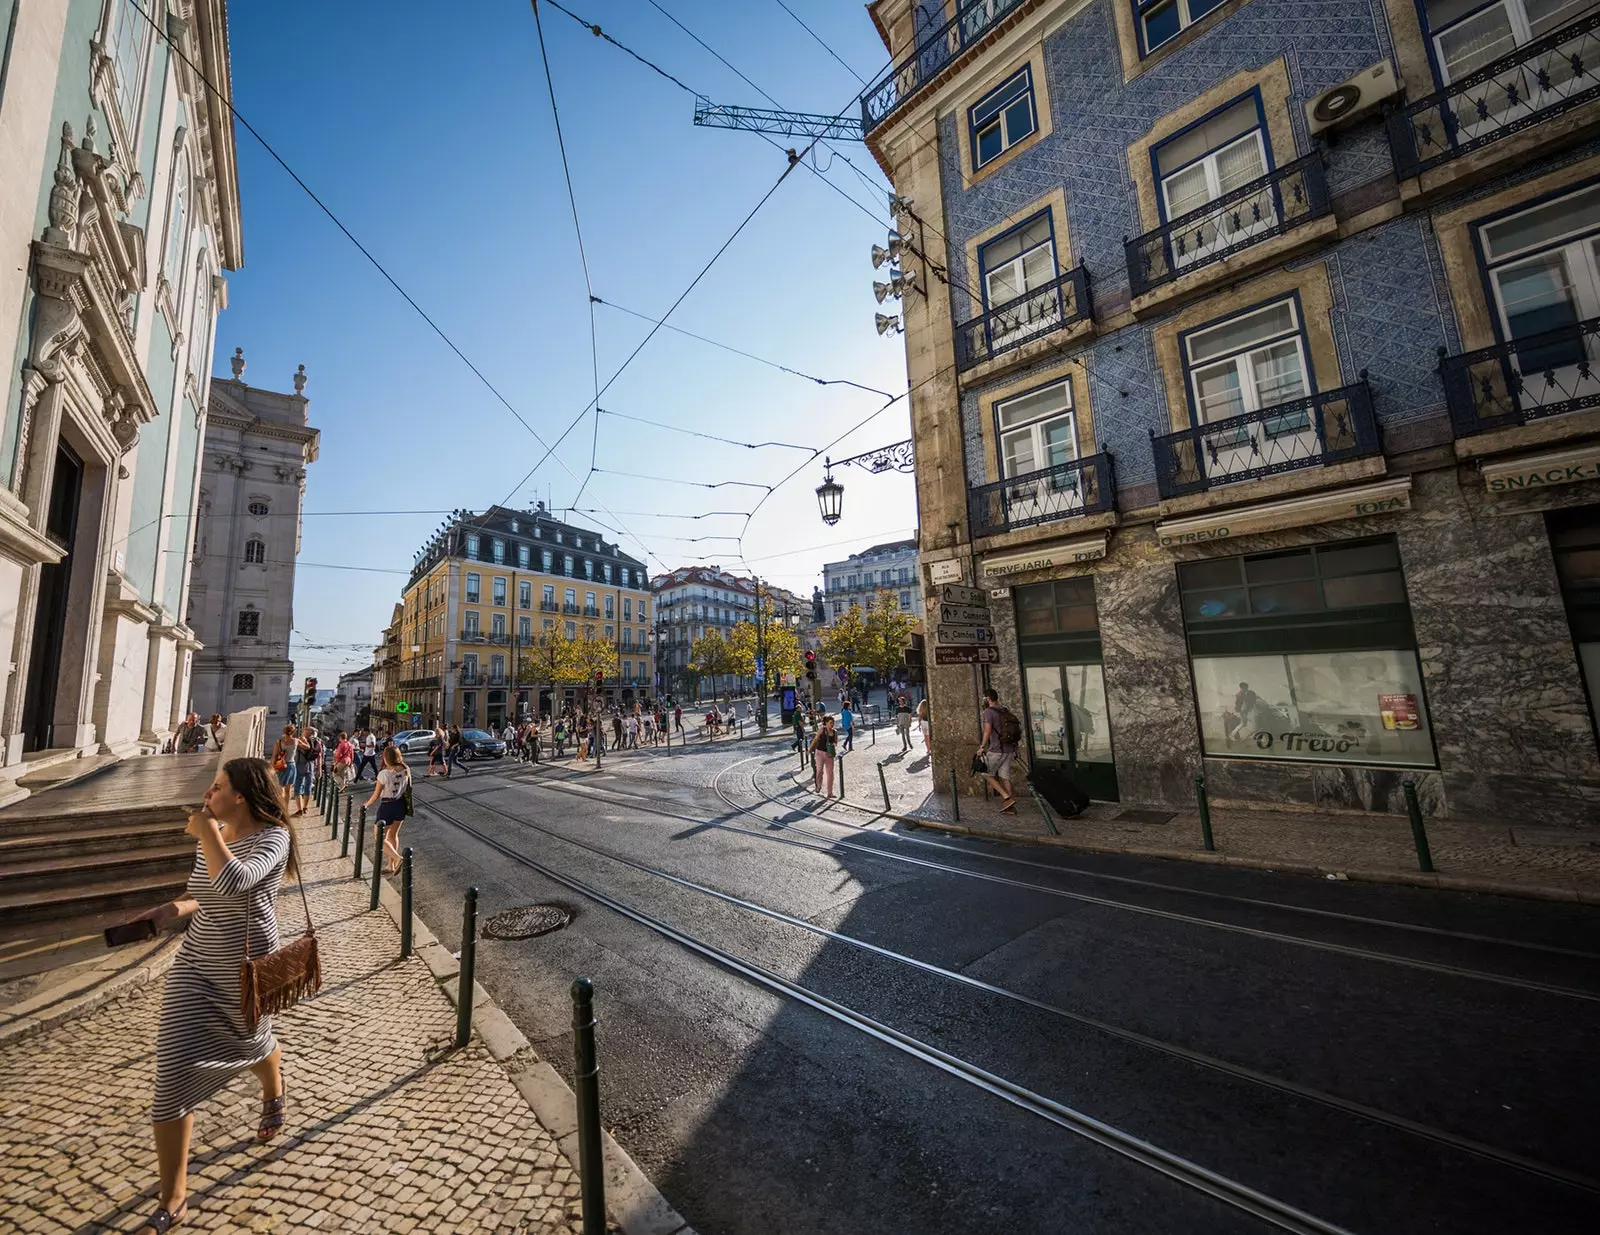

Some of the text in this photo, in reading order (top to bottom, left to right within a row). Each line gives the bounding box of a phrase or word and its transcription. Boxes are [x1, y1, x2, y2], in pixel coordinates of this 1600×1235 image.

[1351, 496, 1406, 515] TOFA
[1161, 527, 1230, 546] O TREVO
[985, 549, 1103, 577] CERVEJARIA TOFA
[1254, 731, 1352, 753] O Trevo
